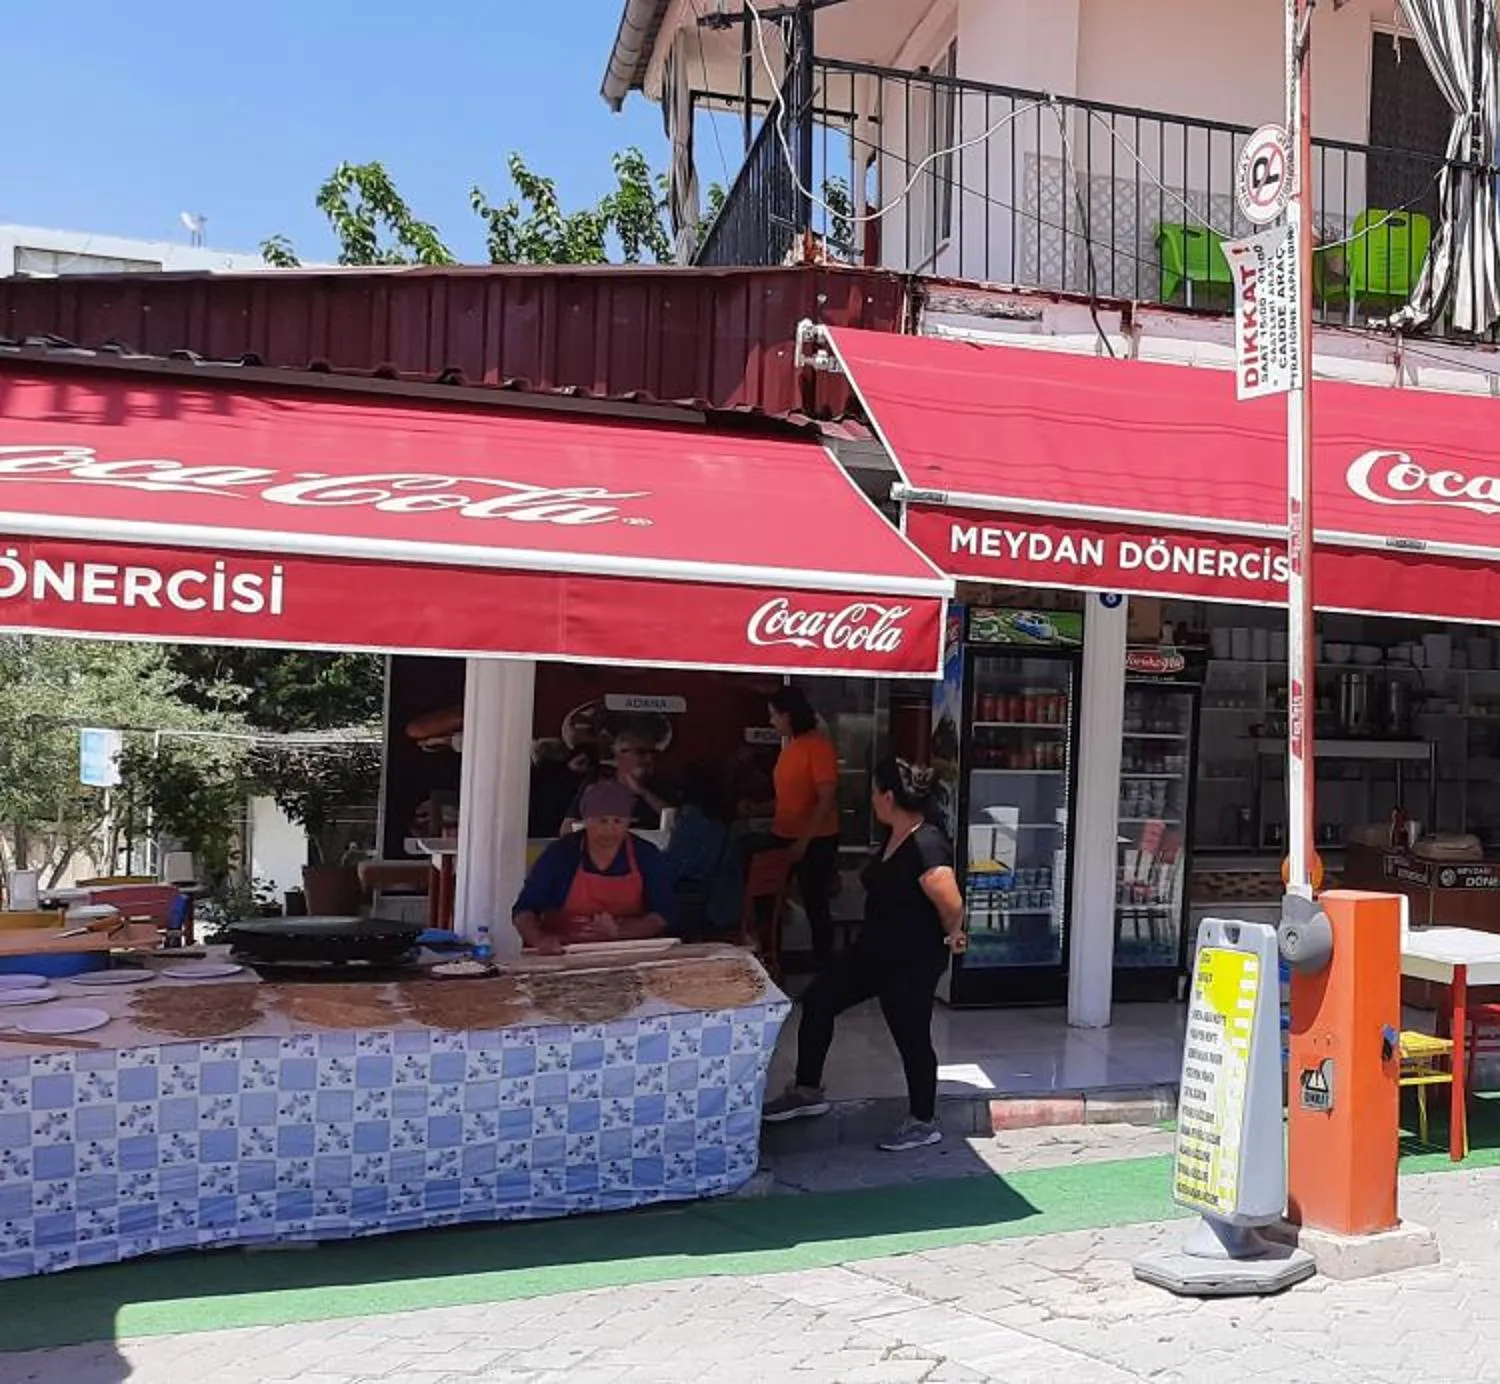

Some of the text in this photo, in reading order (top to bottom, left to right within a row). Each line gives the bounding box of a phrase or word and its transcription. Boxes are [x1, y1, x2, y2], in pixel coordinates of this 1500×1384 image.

[1241, 265, 1260, 387] DİKKAT
[1276, 247, 1287, 369] CADDE ARAÇ
[1260, 345, 1269, 383] SAAT
[950, 524, 1104, 566] MEYDAN
[1118, 537, 1290, 583] DÖNERCİS
[747, 597, 913, 653] Coca-Cola
[625, 698, 668, 709] ADANA
